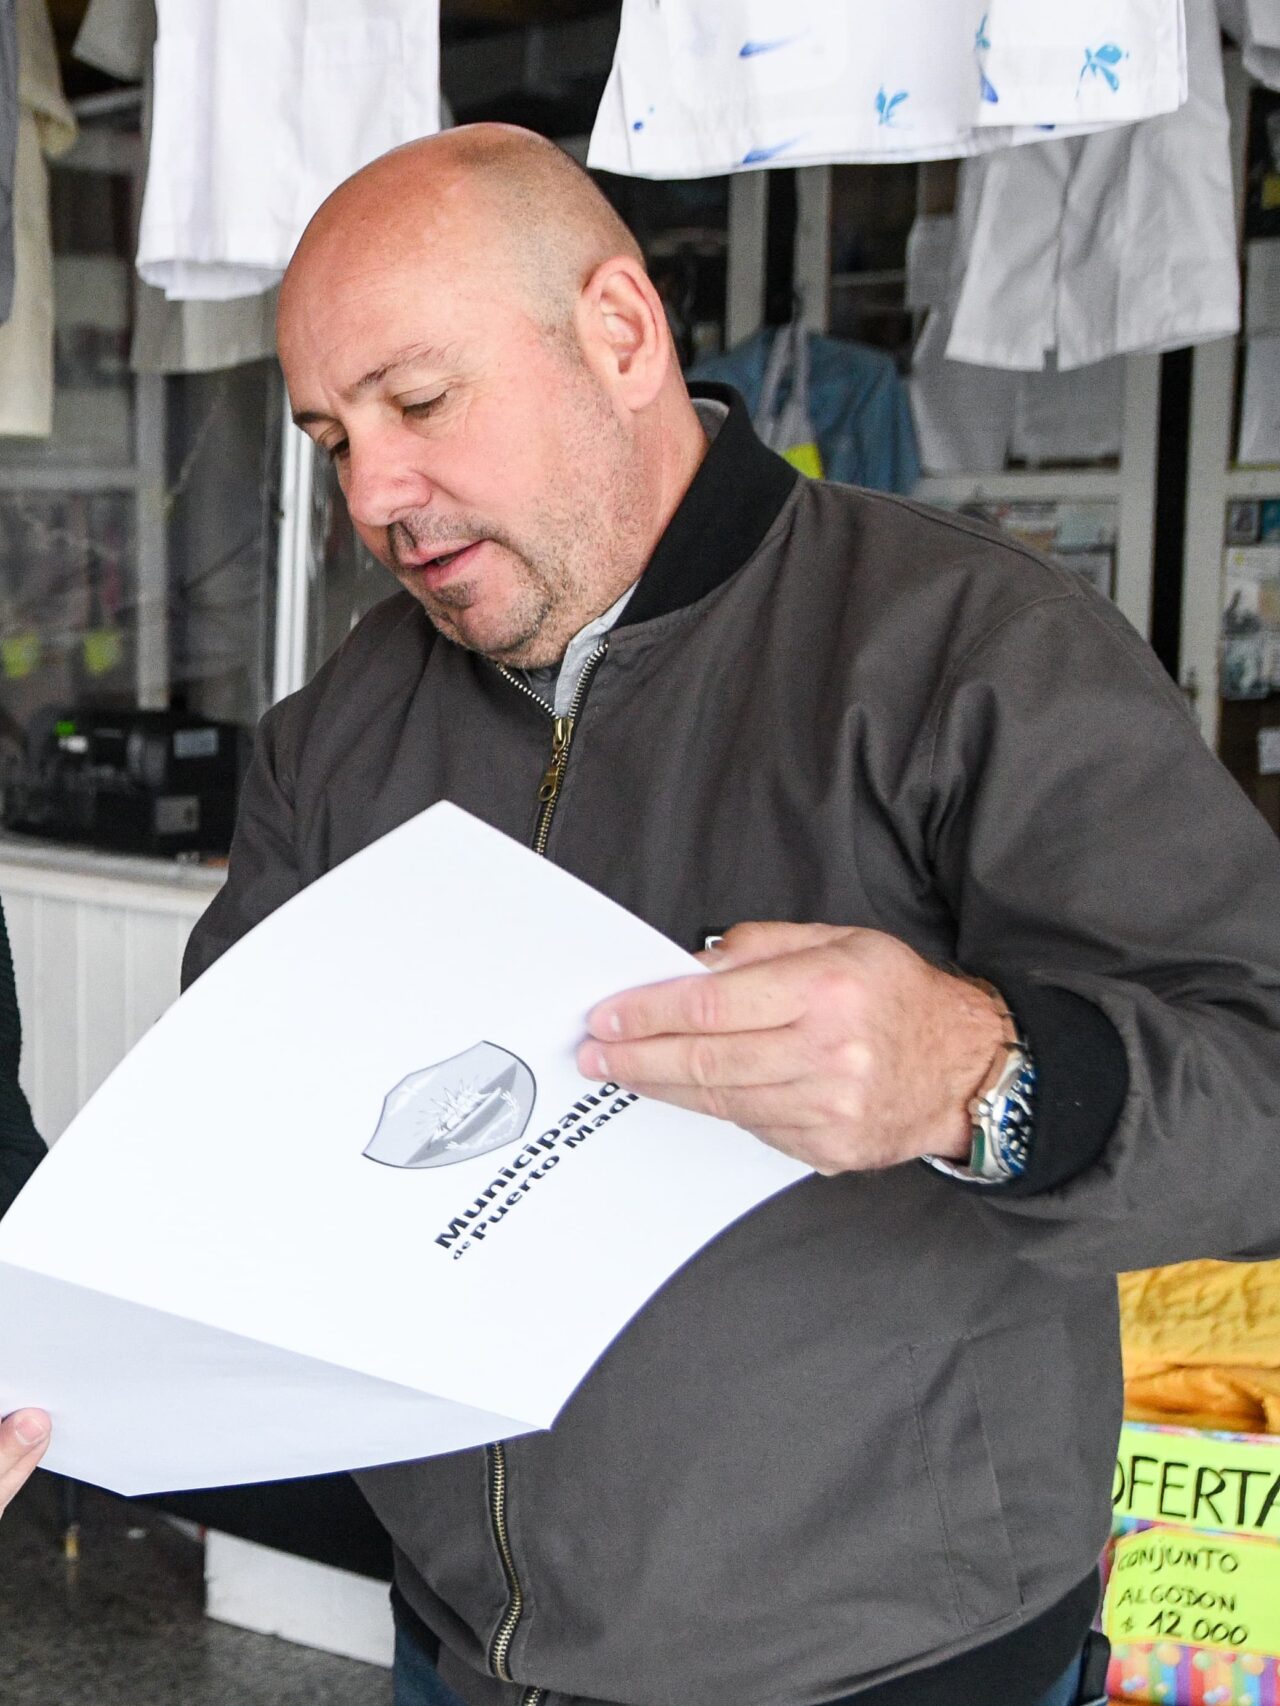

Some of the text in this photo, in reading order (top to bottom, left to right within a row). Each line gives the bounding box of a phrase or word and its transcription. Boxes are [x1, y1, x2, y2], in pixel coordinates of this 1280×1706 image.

[434, 1081, 620, 1249] Municipalid
[453, 1241, 471, 1260] de
[470, 1155, 560, 1241] Puerto
[1117, 1584, 1237, 1613] ALGODON
